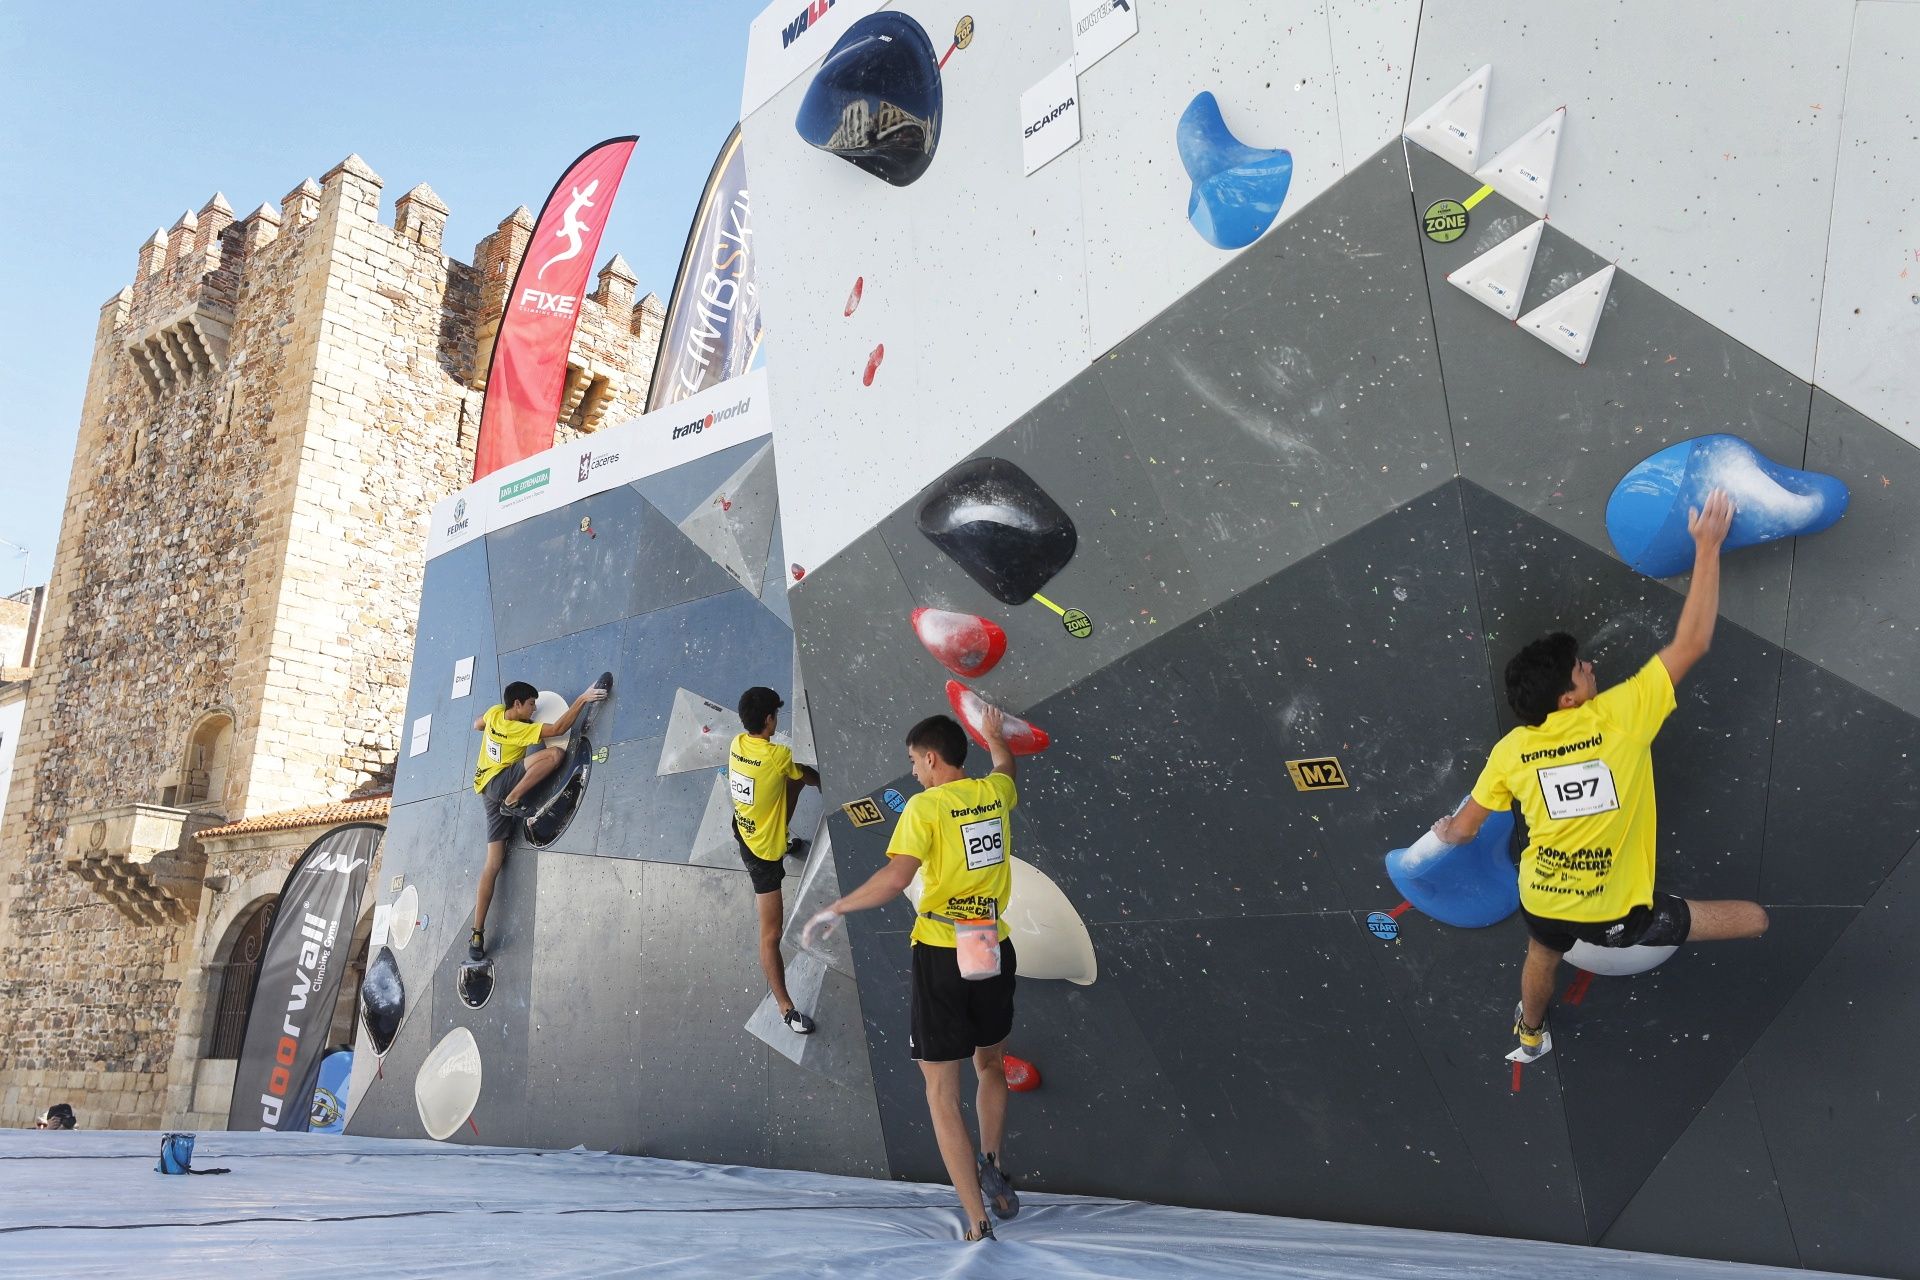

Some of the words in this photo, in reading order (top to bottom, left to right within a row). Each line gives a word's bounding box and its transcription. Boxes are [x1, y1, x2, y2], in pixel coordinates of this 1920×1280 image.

[956, 23, 972, 43] TOP
[1024, 97, 1075, 139] SCARPA
[1426, 214, 1467, 232] ZONE
[520, 288, 577, 315] FIXE
[447, 519, 469, 536] FEDME
[1066, 617, 1091, 632] ZONE
[1301, 765, 1342, 785] M2
[1555, 777, 1600, 802] 197
[853, 803, 879, 822] M3
[969, 833, 1002, 855] 206
[1368, 923, 1398, 932] START
[313, 949, 331, 993] Climbing
[324, 920, 338, 949] Gyms
